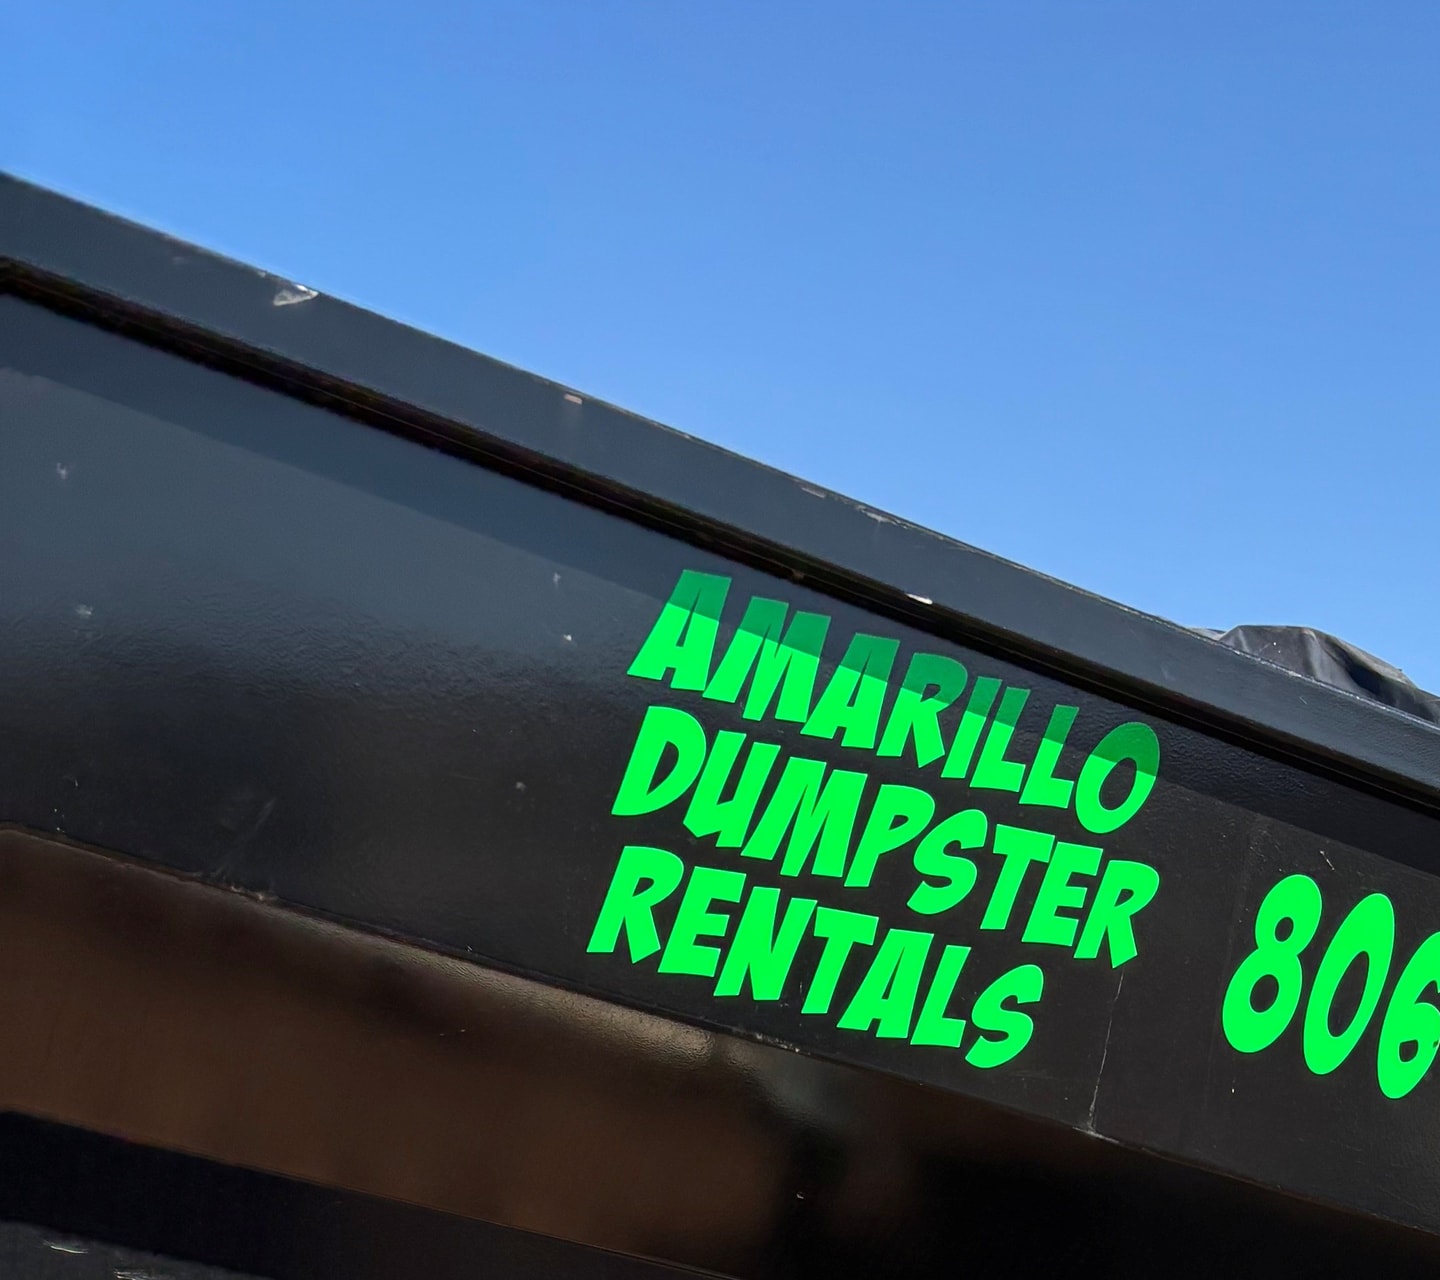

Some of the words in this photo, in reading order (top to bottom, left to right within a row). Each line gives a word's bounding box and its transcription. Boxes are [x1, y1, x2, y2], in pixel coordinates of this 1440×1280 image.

[626, 570, 1160, 834] AMARILLO
[586, 845, 1044, 1068] RENTALS
[611, 705, 1160, 968] DUMPSTER
